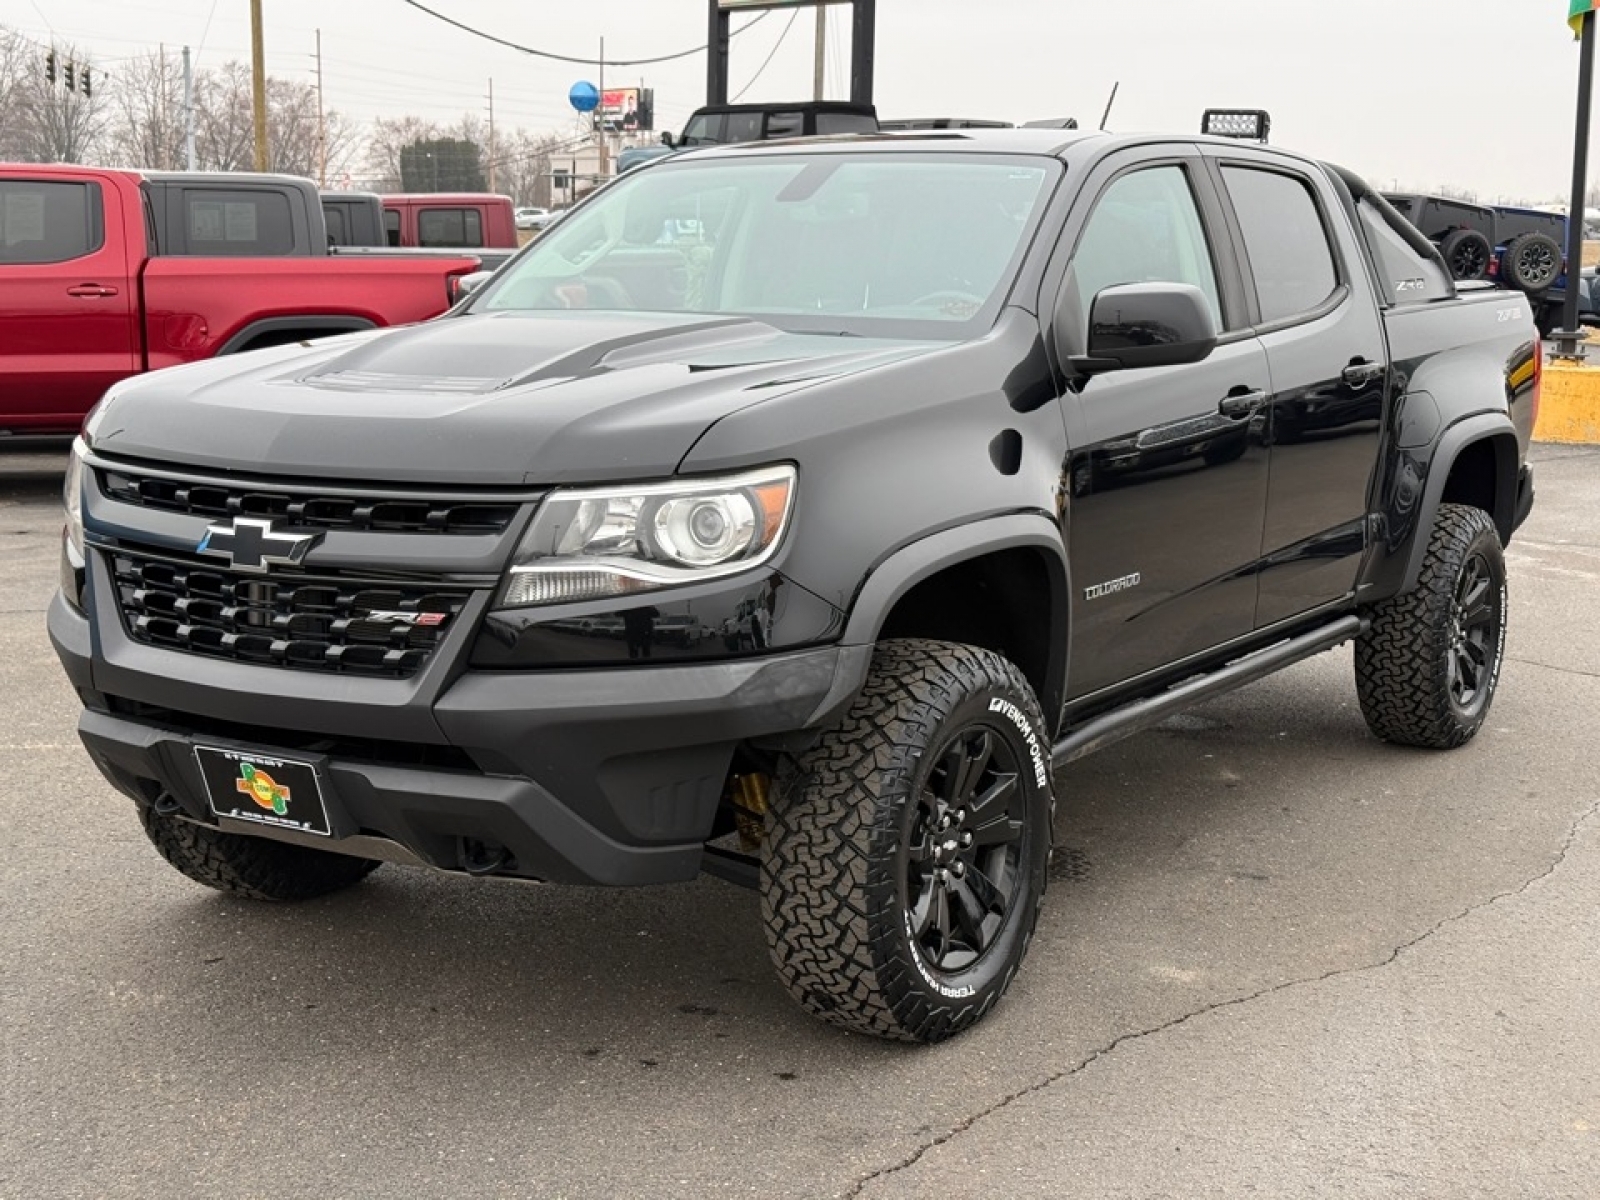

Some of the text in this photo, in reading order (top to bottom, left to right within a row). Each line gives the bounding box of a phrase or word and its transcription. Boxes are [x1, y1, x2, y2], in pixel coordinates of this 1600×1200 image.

[1083, 572, 1140, 600] COLORADO
[365, 609, 447, 626] ZR2
[1001, 699, 1047, 789] VENOM POWER
[941, 984, 976, 998] TERRA
